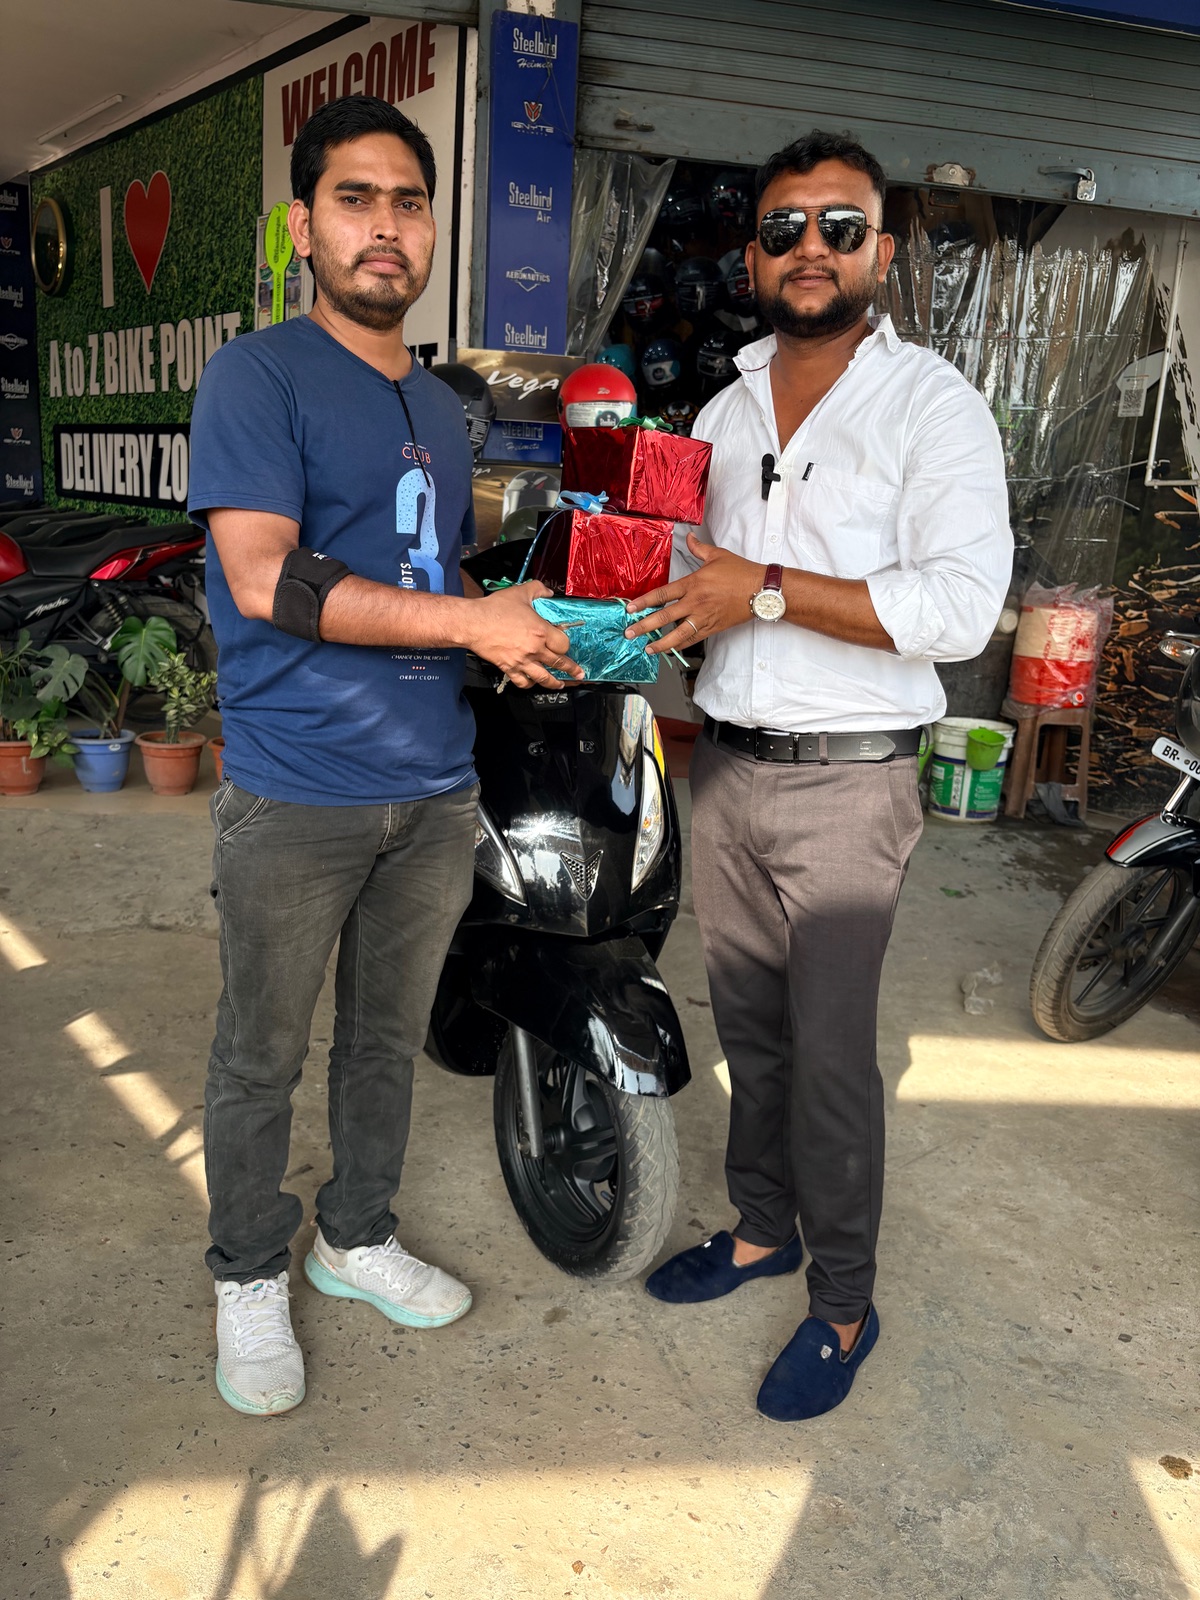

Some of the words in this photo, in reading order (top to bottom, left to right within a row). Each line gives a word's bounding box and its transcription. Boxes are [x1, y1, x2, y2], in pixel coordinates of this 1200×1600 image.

[513, 27, 557, 59] Steelbird
[511, 121, 554, 134] IGNYTE
[508, 181, 553, 211] Steelbird
[536, 211, 552, 224] Air
[100, 185, 115, 308] I
[505, 270, 551, 283] AERONAUTICS
[505, 323, 548, 349] Steelbird
[49, 340, 63, 398] A
[64, 342, 85, 397] to
[88, 333, 101, 396] Z
[103, 324, 156, 395] BIKE
[502, 422, 544, 441] Steelbird
[402, 446, 431, 464] CLUB
[60, 432, 154, 498] DELIVERY
[158, 432, 192, 503] ZO
[1162, 744, 1180, 761] BR-
